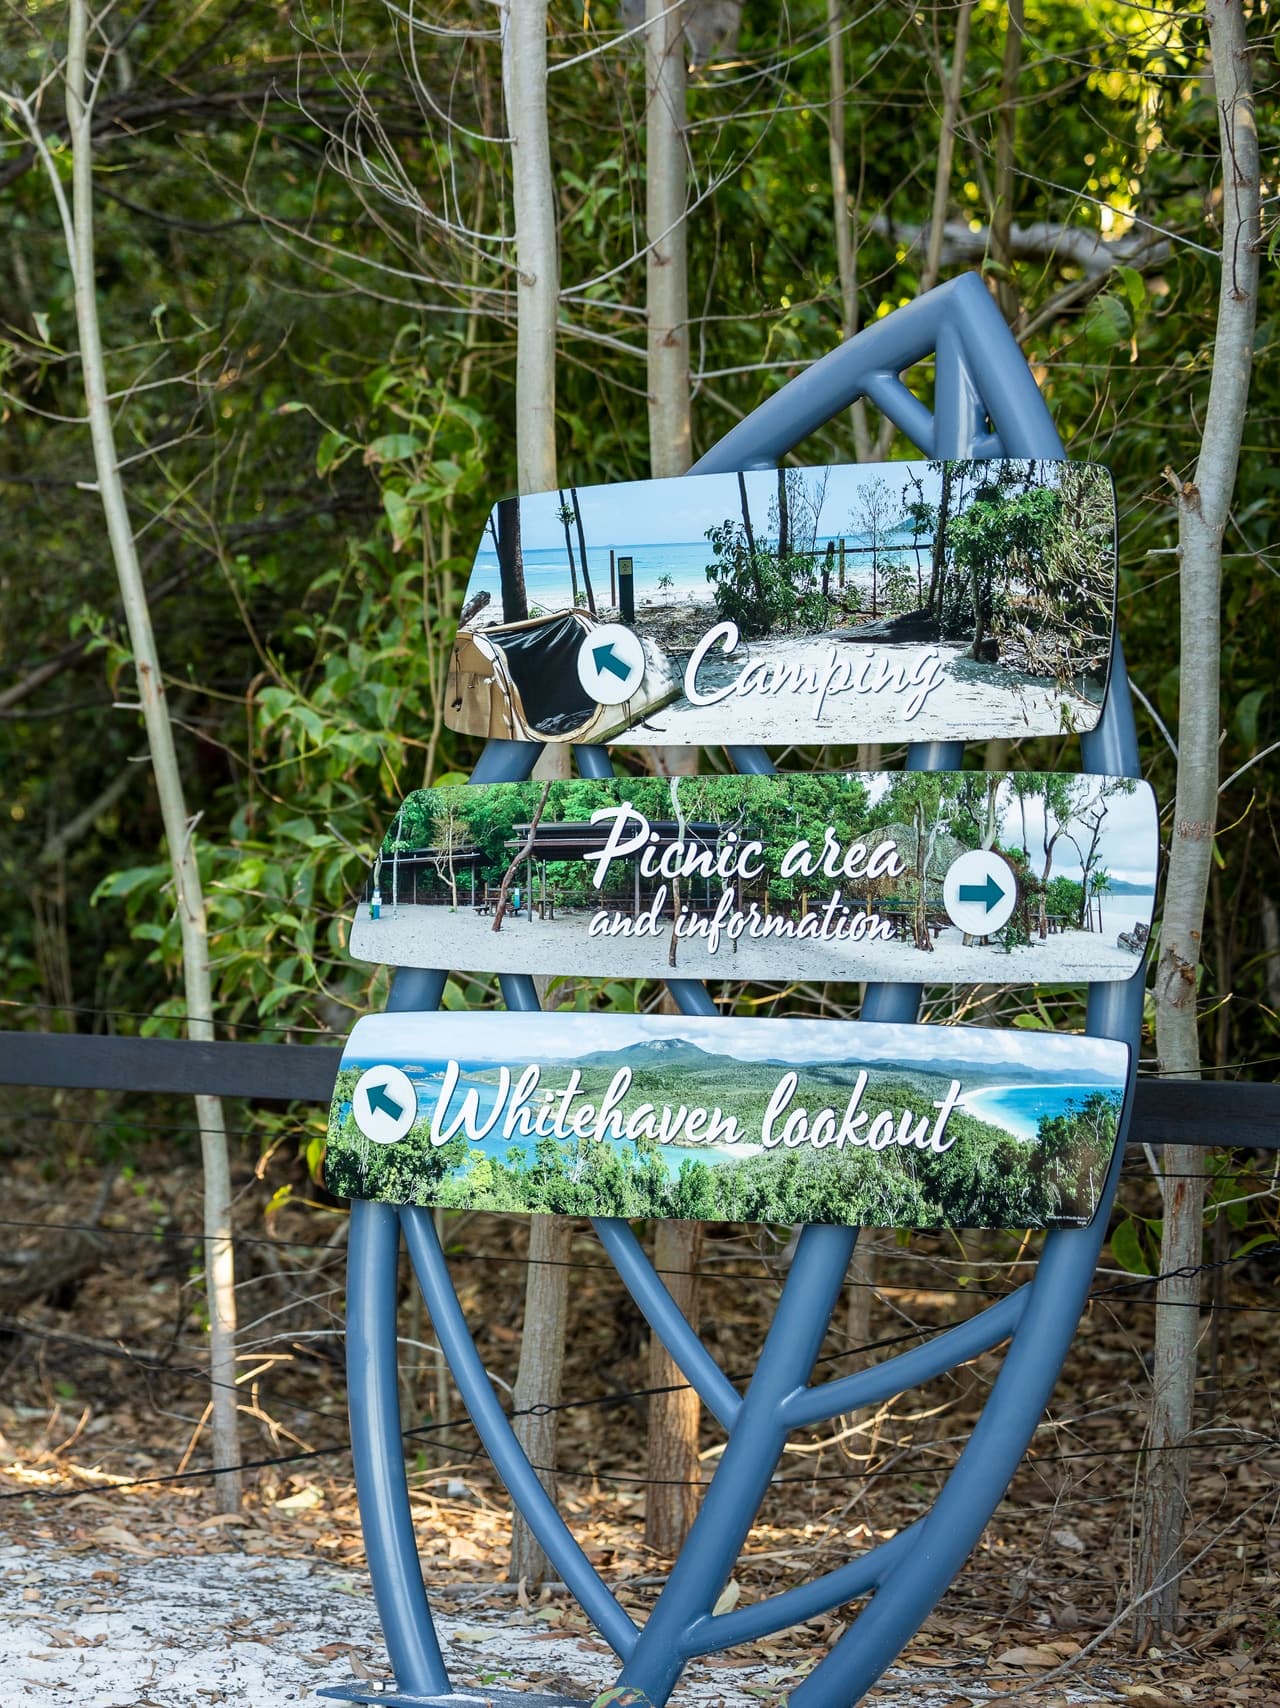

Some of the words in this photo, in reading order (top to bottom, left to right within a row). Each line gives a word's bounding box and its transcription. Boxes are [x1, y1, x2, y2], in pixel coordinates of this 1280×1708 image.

[684, 621, 945, 721] Camping
[583, 801, 765, 889] Picnic
[780, 827, 906, 879] area
[588, 884, 668, 937] and
[675, 888, 896, 954] information
[430, 1059, 745, 1147] Whitehaven
[762, 1070, 966, 1153] lookout
